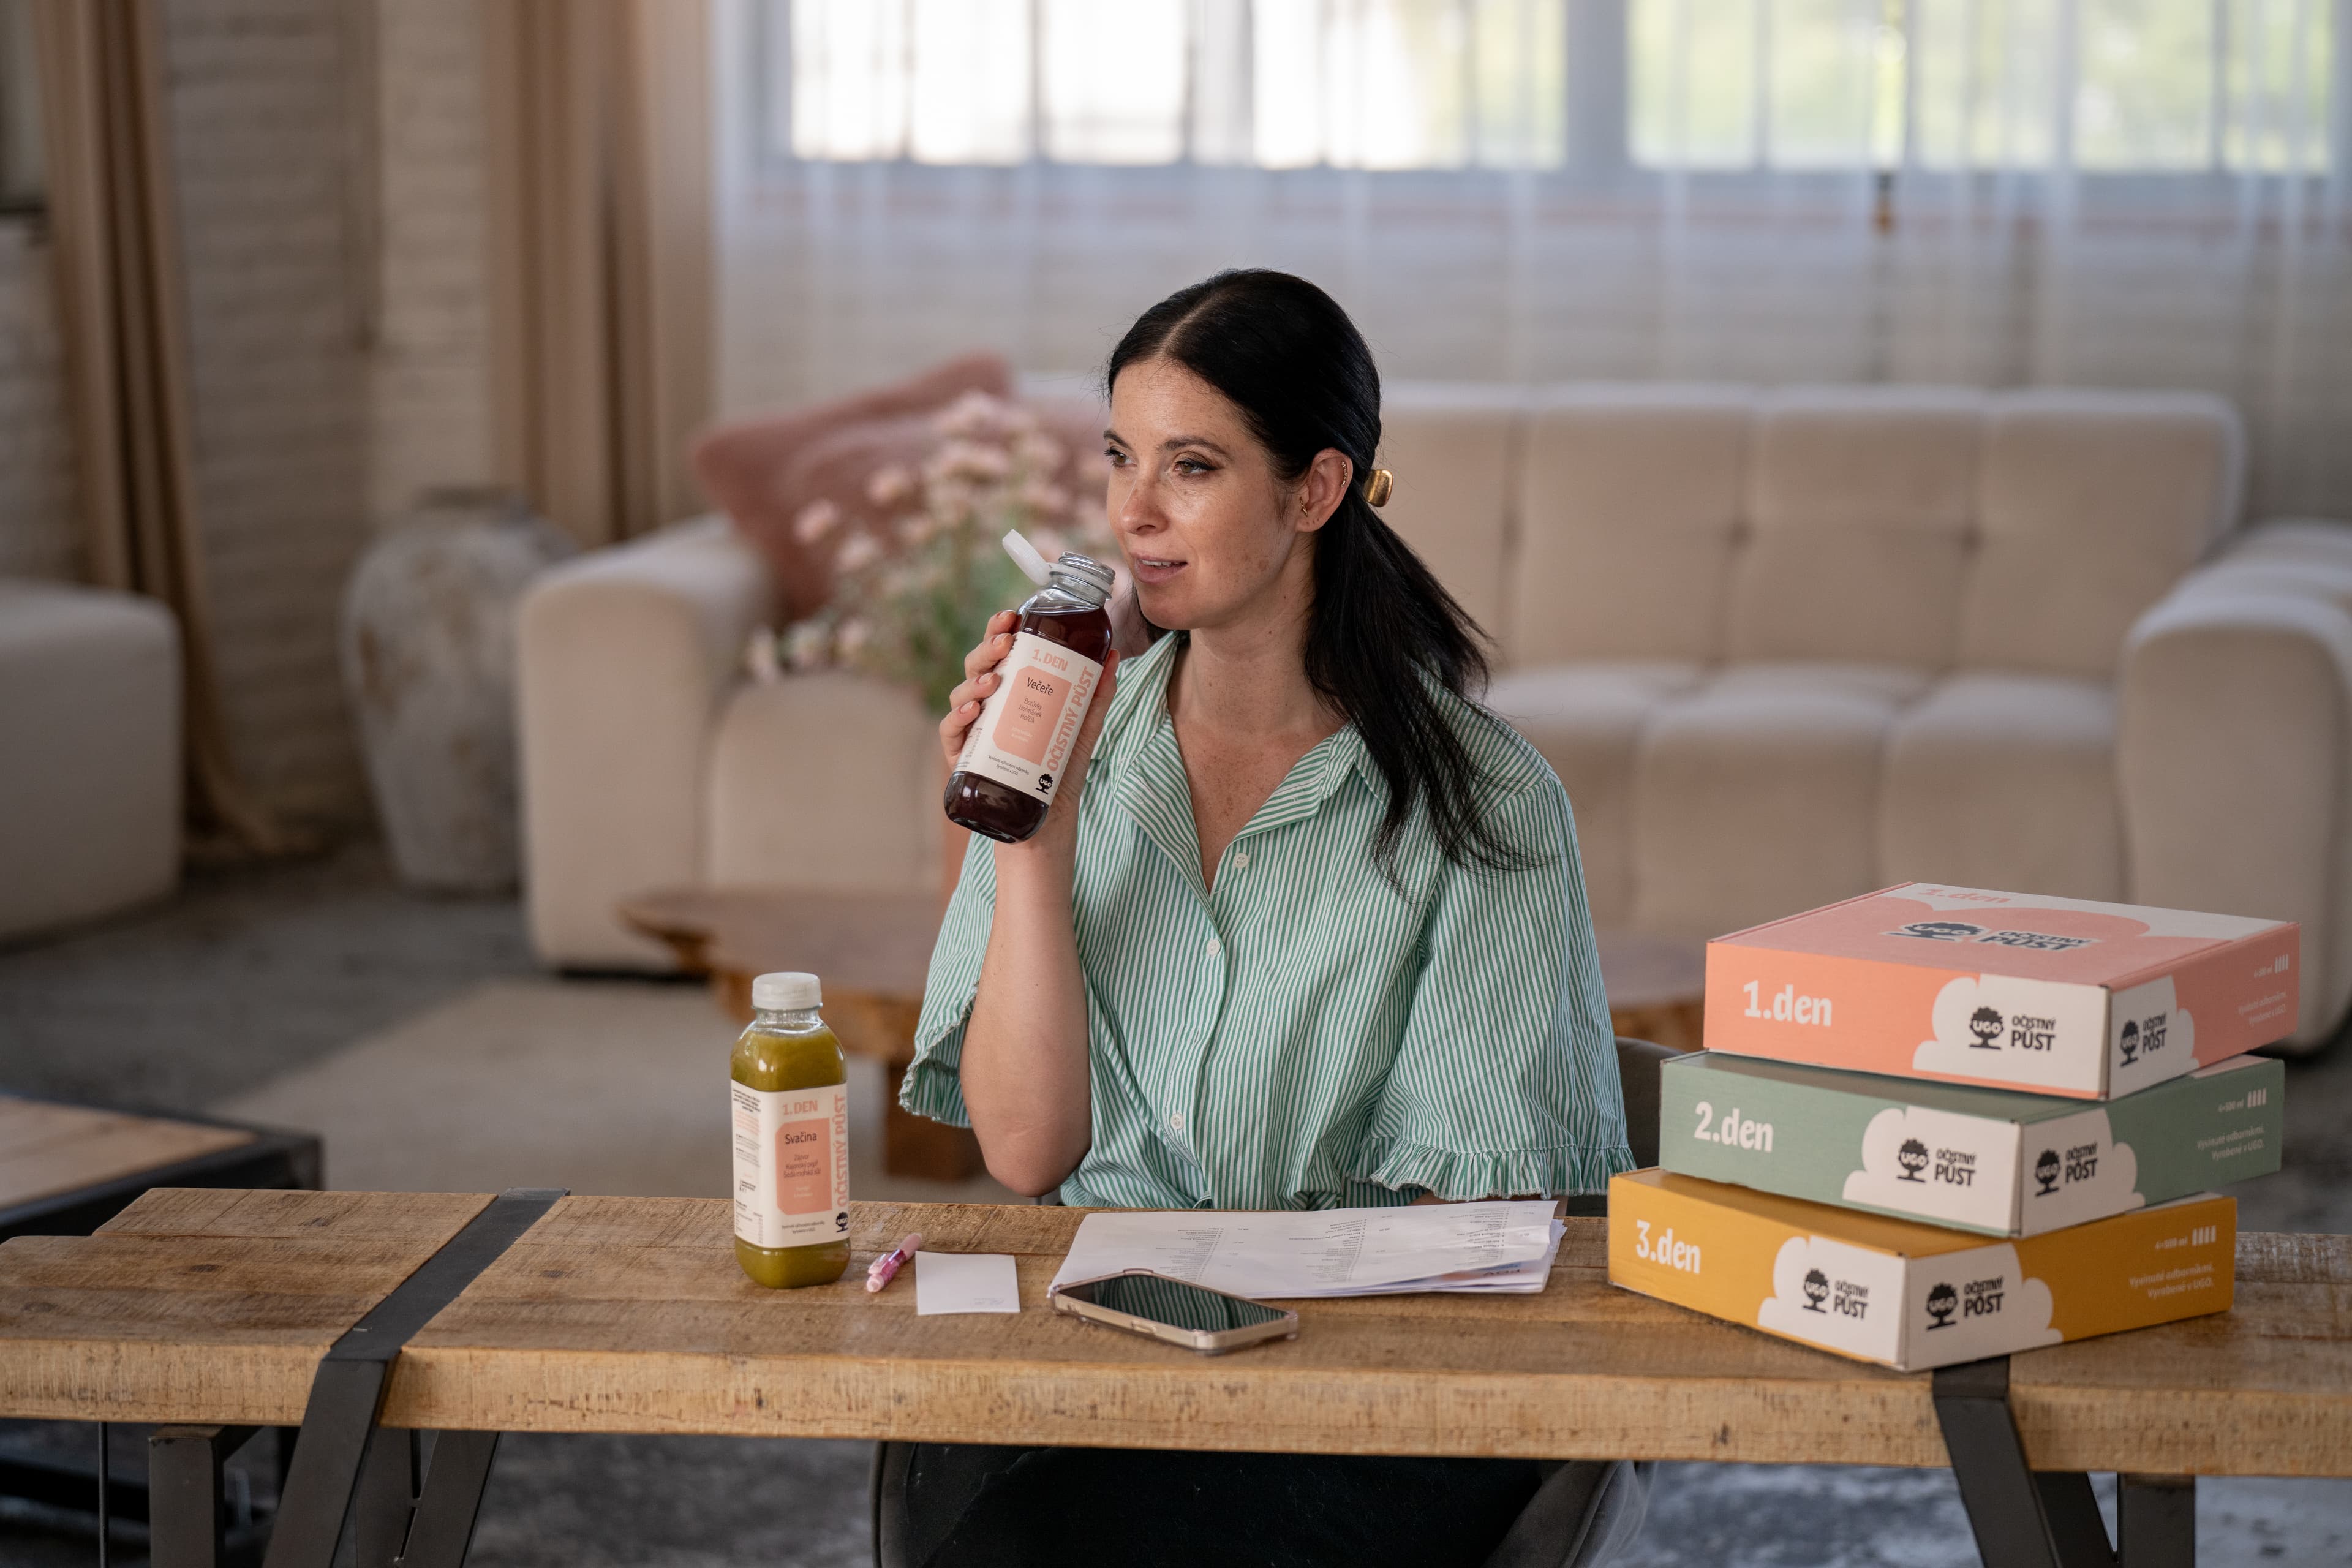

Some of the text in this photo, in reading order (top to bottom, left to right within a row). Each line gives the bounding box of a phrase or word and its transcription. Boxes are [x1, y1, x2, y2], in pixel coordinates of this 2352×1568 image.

[1032, 649, 1069, 671] 1. DEN
[1027, 677, 1054, 696] Večeře
[1023, 698, 1043, 710] Borůvky
[1046, 666, 1094, 772] OČISTNÝ PŮST
[1039, 778, 1052, 788] UGO
[1918, 889, 2011, 903] 1.den
[1743, 979, 1833, 1027] 1.den
[1972, 1020, 2002, 1035] UGO
[2011, 1028, 2056, 1051] PŮST
[783, 1100, 818, 1115] 1. DEN
[785, 1131, 817, 1144] Svačina
[1694, 1101, 1774, 1153] 2.den
[832, 1094, 848, 1207] OČISTNÝ PŮST
[1900, 1152, 1928, 1167] UGO
[1935, 1163, 1975, 1186] PŮST
[1636, 1219, 1701, 1274] 3.den
[1834, 1294, 1868, 1319] PŮST
